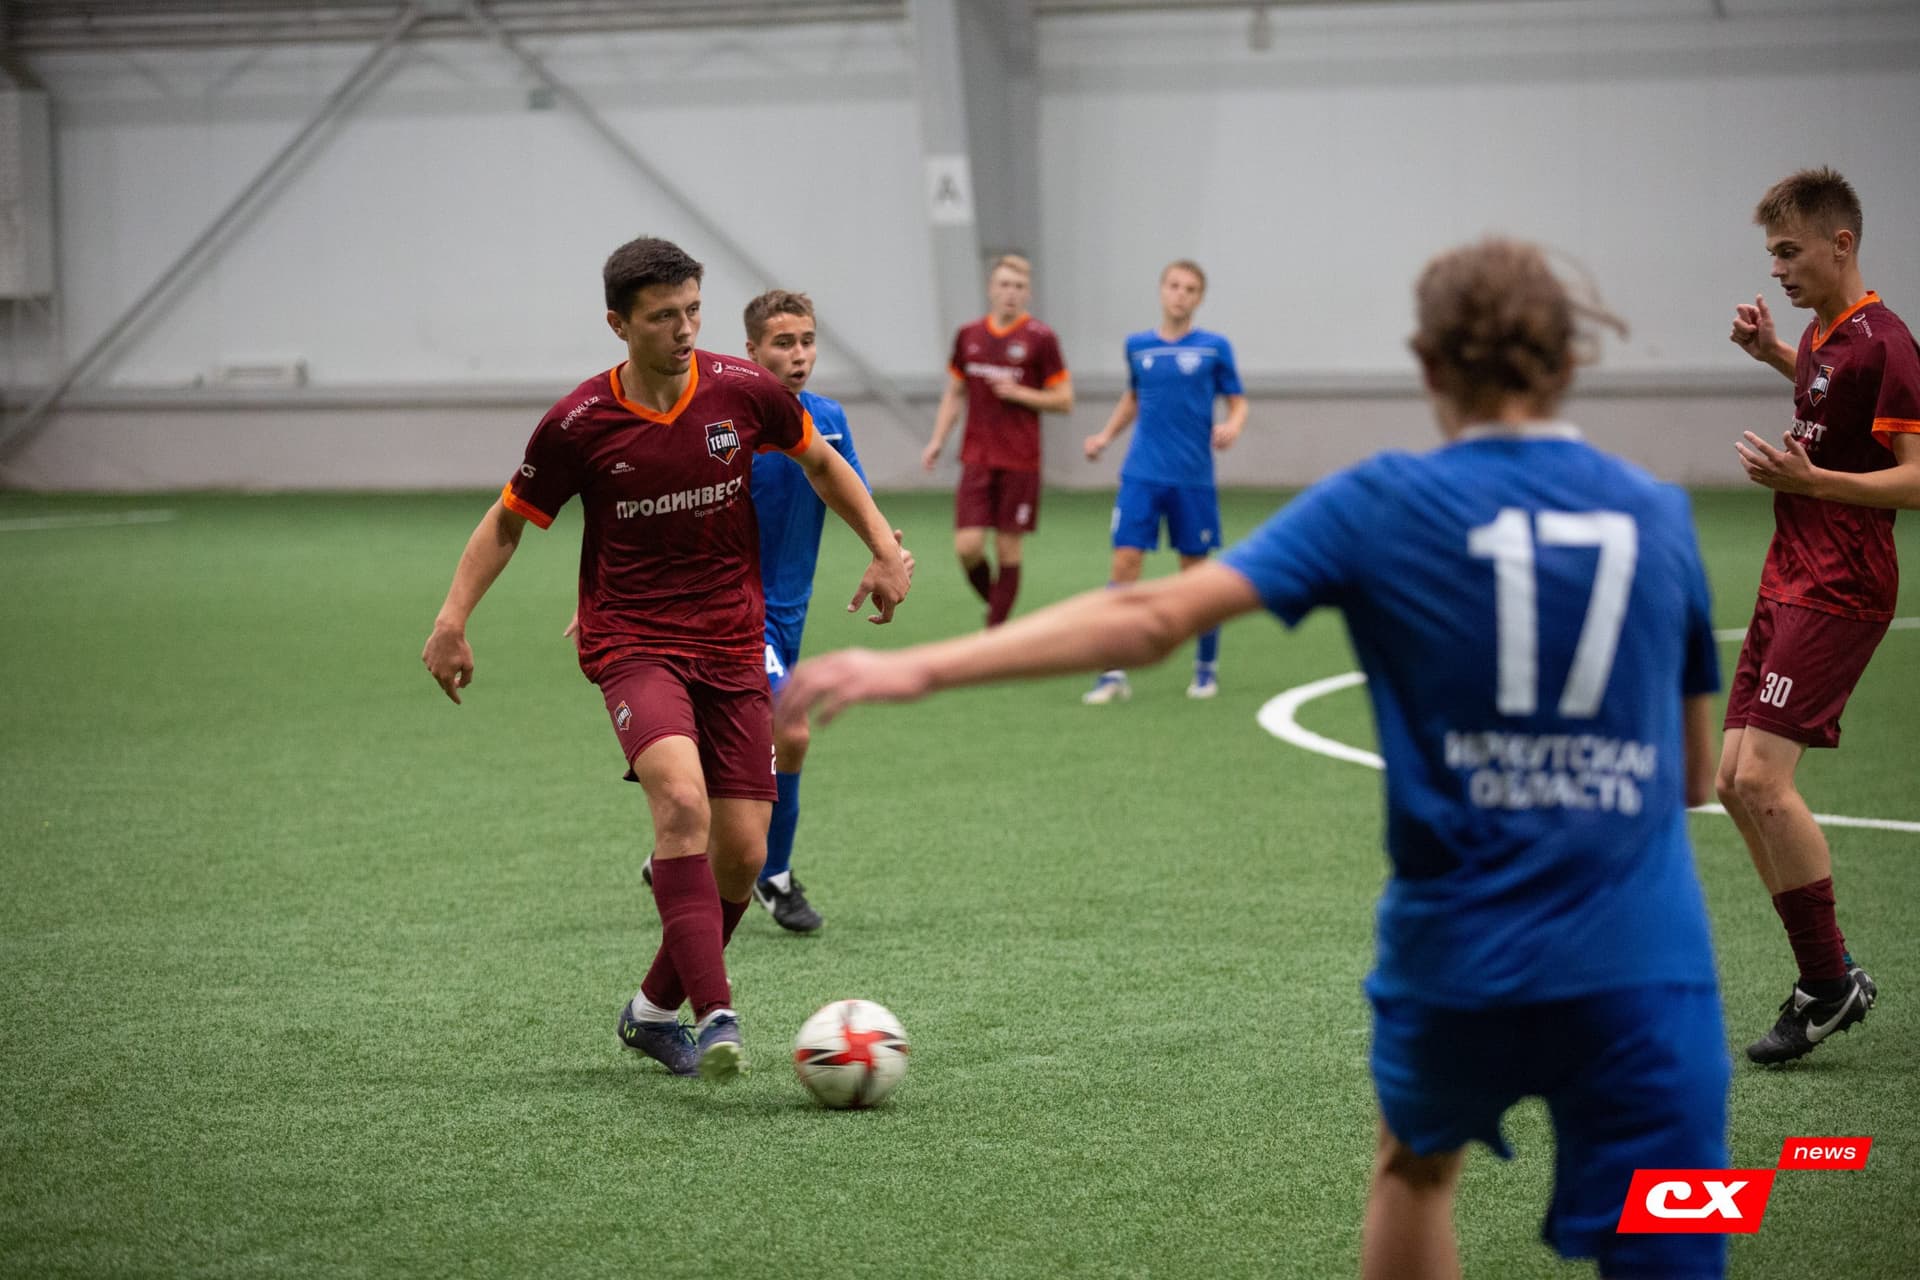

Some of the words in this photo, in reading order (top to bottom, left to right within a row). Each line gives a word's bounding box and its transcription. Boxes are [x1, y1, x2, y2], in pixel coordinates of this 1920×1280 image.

[709, 432, 737, 452] ТЕМП
[1466, 506, 1639, 719] 17
[1759, 671, 1794, 709] 30
[1469, 767, 1643, 816] ОБЛАСТЬ
